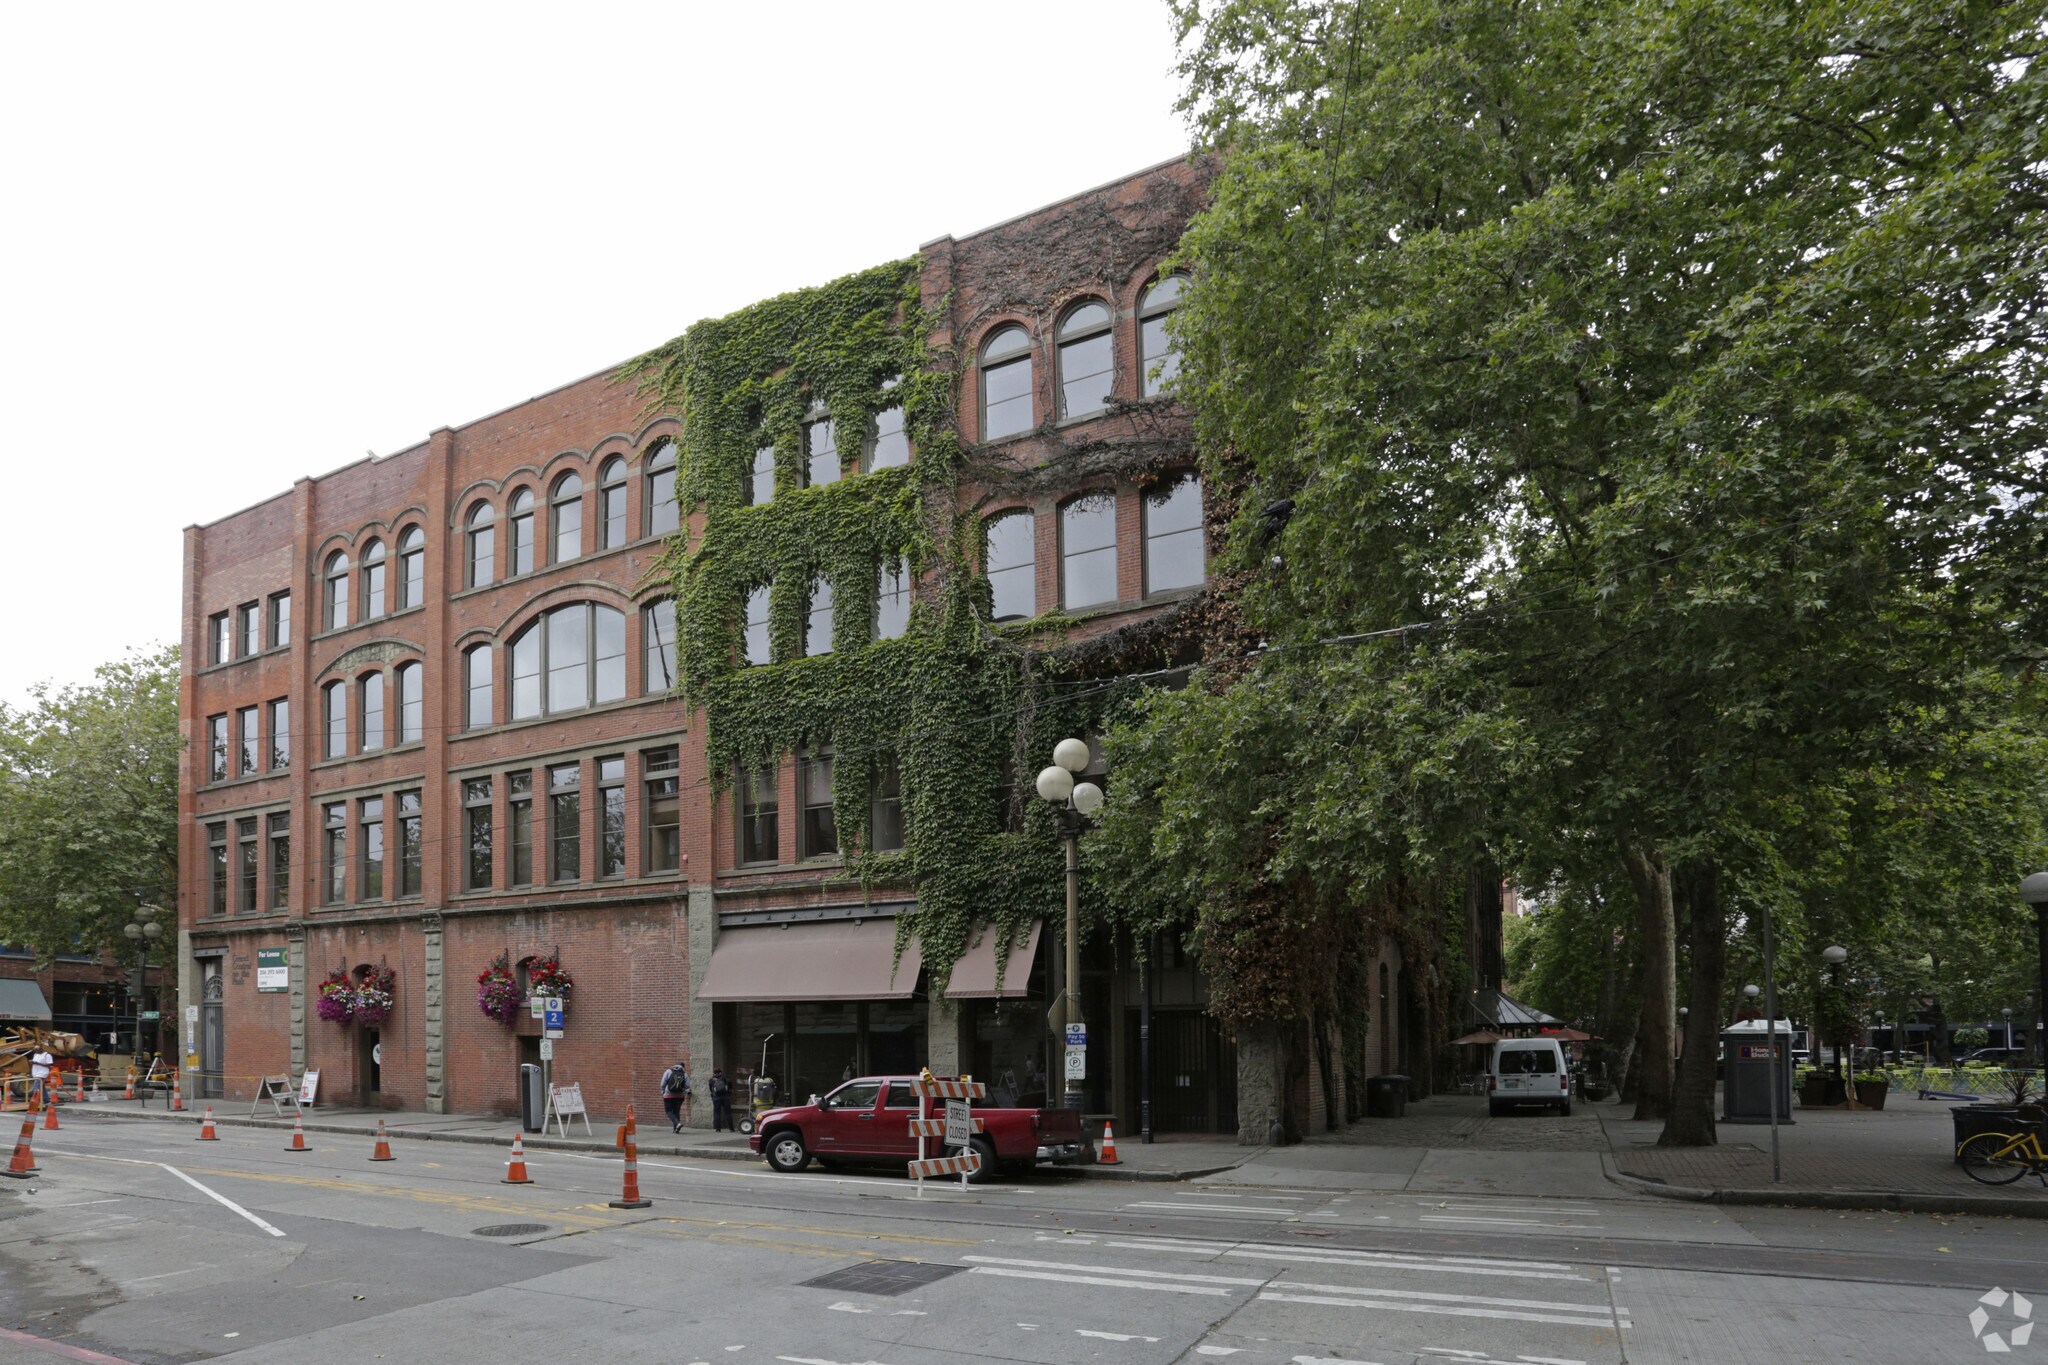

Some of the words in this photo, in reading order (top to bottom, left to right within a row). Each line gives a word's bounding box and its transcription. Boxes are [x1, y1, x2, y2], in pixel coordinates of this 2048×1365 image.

[551, 1013, 557, 1022] 2
[950, 1107, 966, 1121] STREET
[949, 1126, 967, 1139] CLOSED
